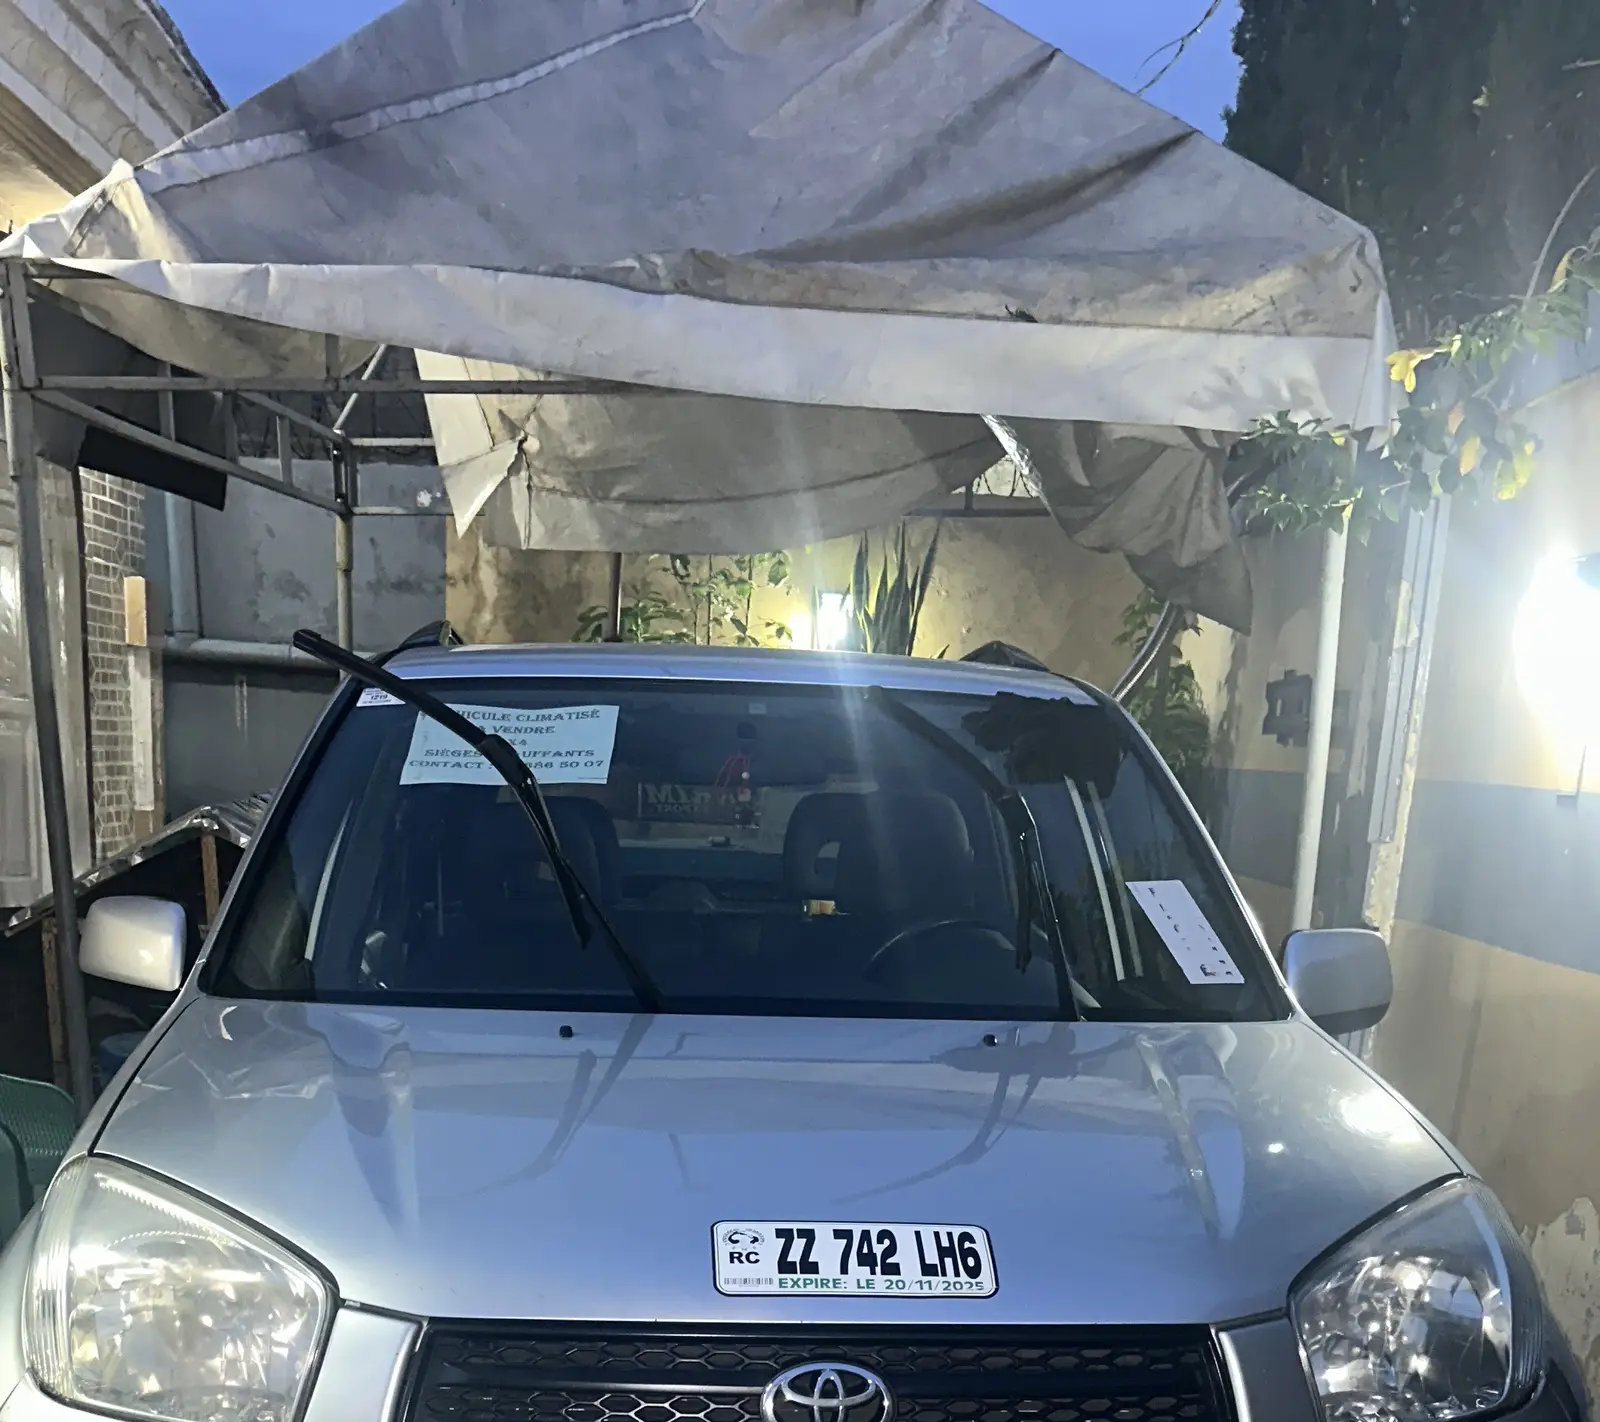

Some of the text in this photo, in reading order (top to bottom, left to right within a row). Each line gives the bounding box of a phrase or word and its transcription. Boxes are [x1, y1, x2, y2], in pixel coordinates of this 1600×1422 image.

[492, 725, 556, 734] VENDRE
[729, 1251, 760, 1264] RC
[774, 1228, 820, 1275] ZZ
[832, 1228, 902, 1276] 742
[914, 1230, 983, 1280] LH6
[778, 1277, 848, 1290] EXPIRE:
[856, 1279, 876, 1290] LE
[885, 1278, 985, 1291] 20/11/2025
